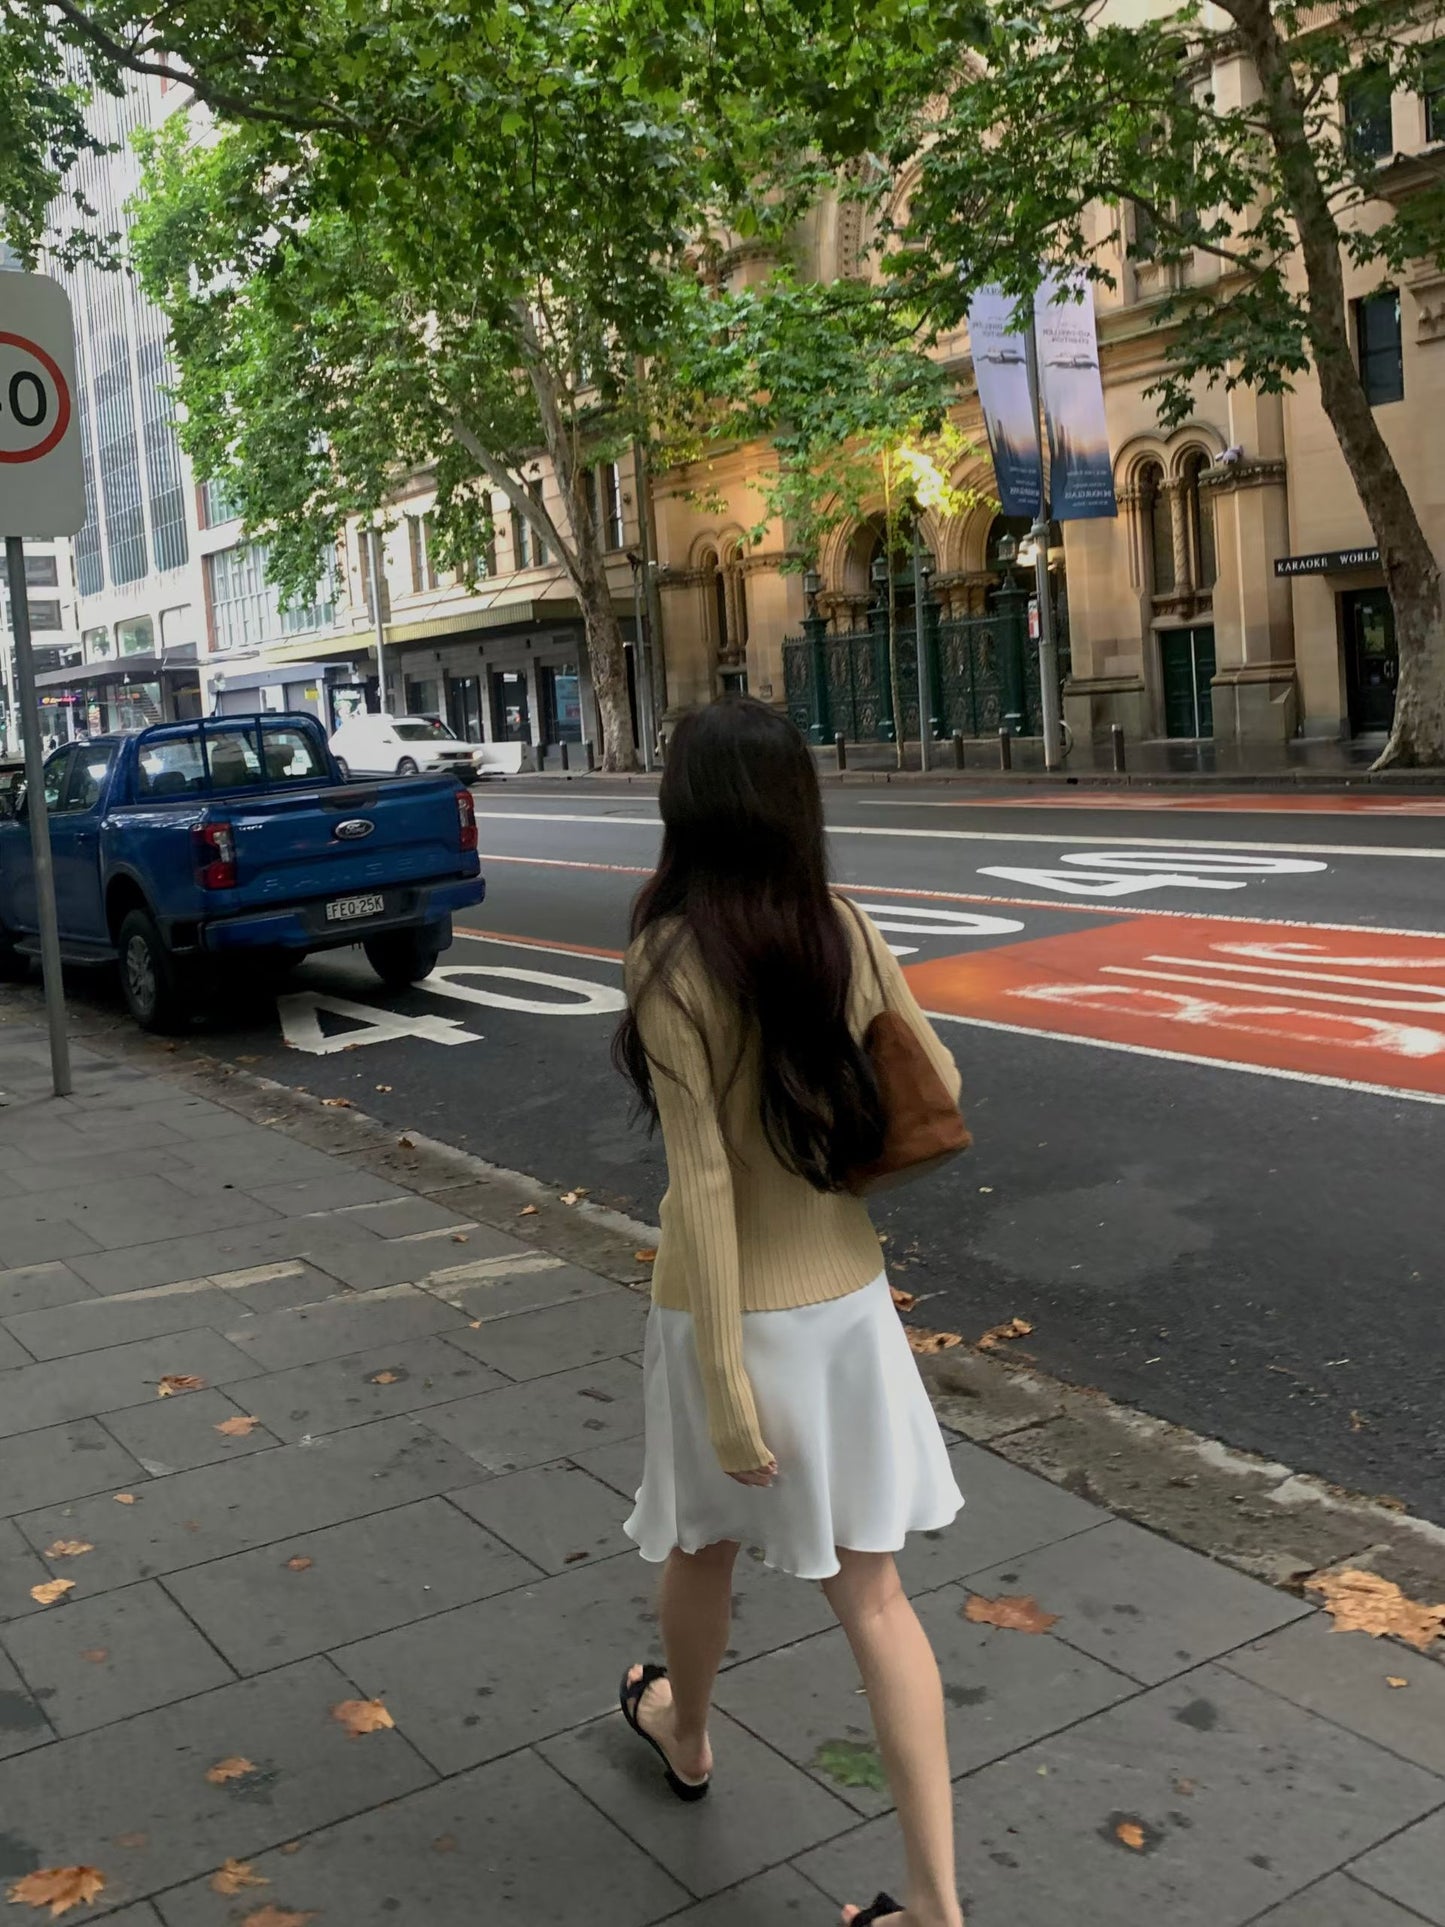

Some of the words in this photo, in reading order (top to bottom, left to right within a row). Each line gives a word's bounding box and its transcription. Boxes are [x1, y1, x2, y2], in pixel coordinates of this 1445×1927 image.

[0, 371, 47, 426] 0
[1277, 557, 1328, 573] KARAOKE
[1339, 550, 1379, 565] WORLD
[977, 852, 1328, 896] 40
[277, 966, 628, 1056] 40
